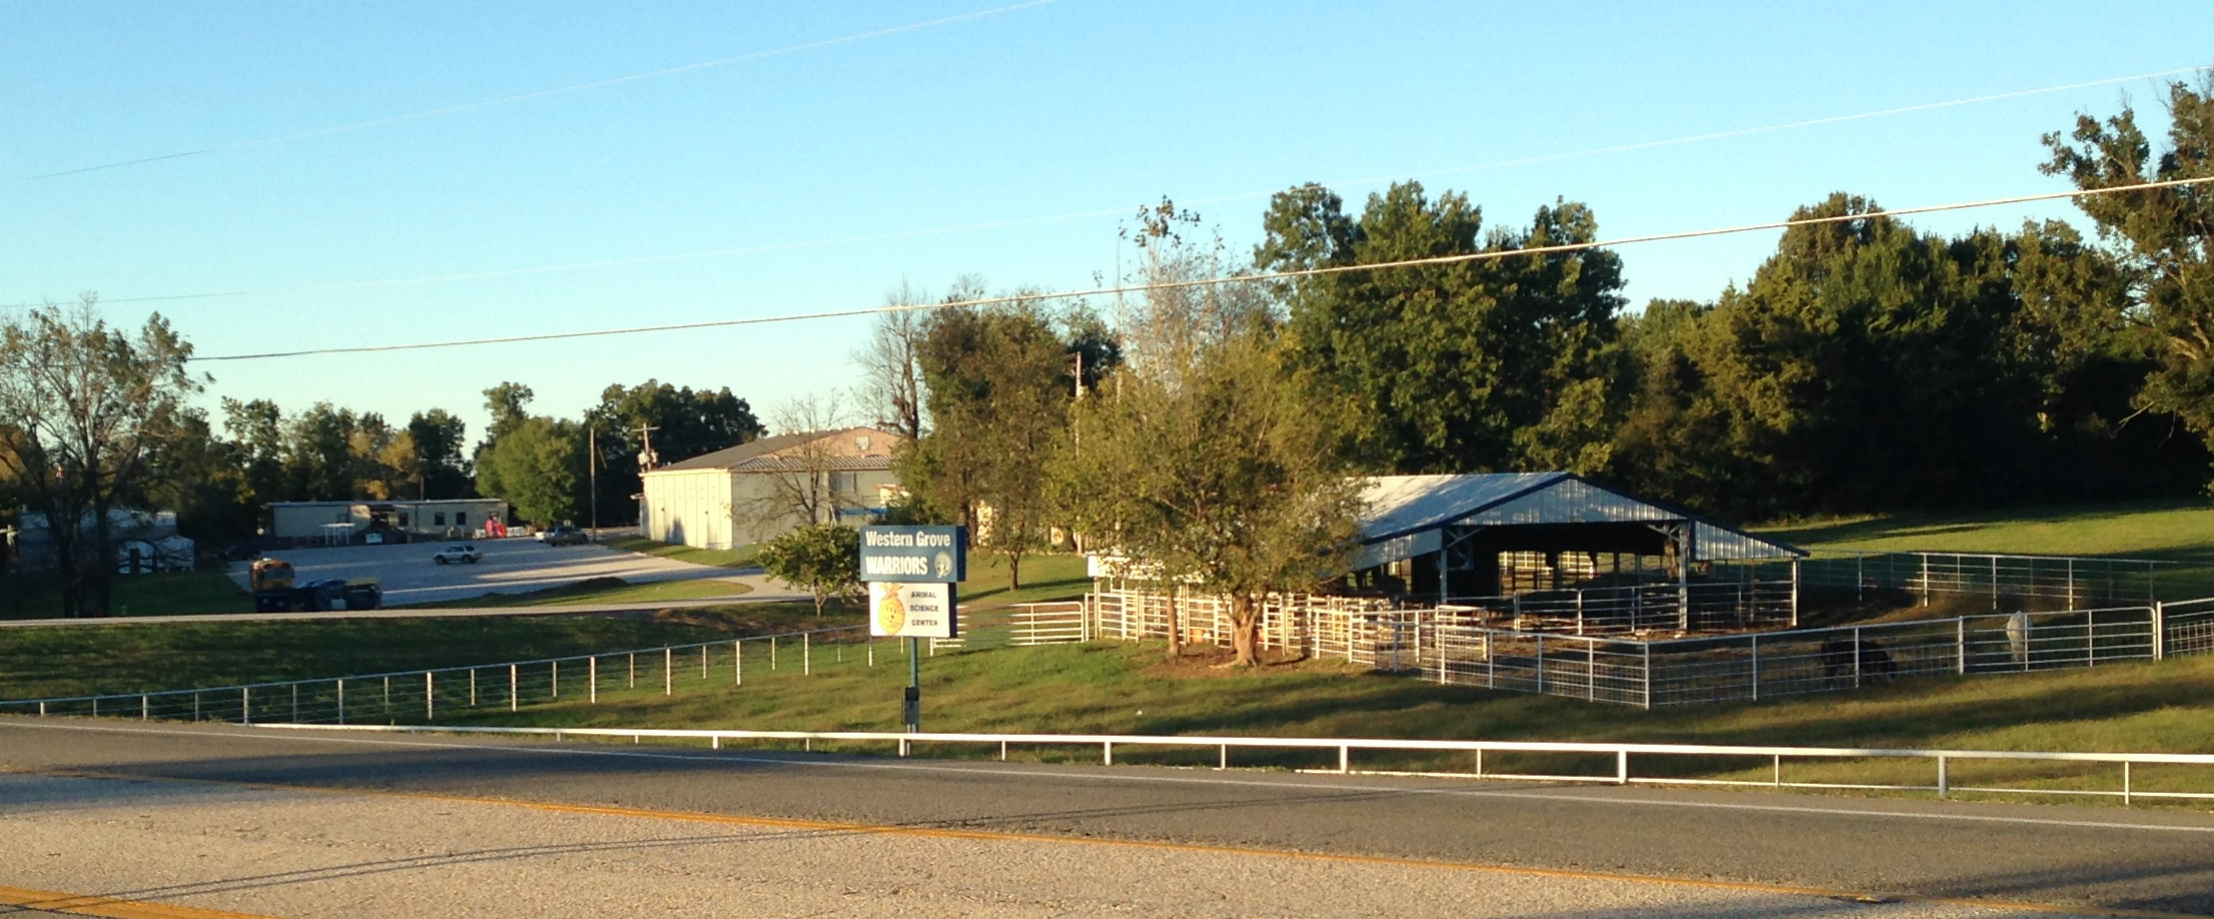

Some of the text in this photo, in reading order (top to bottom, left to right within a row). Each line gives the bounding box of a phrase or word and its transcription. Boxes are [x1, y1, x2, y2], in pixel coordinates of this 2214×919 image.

[865, 530, 951, 547] Western Grove
[865, 556, 928, 575] WARRIORS
[911, 591, 937, 599] ANIMAL
[911, 619, 938, 627] CENTER
